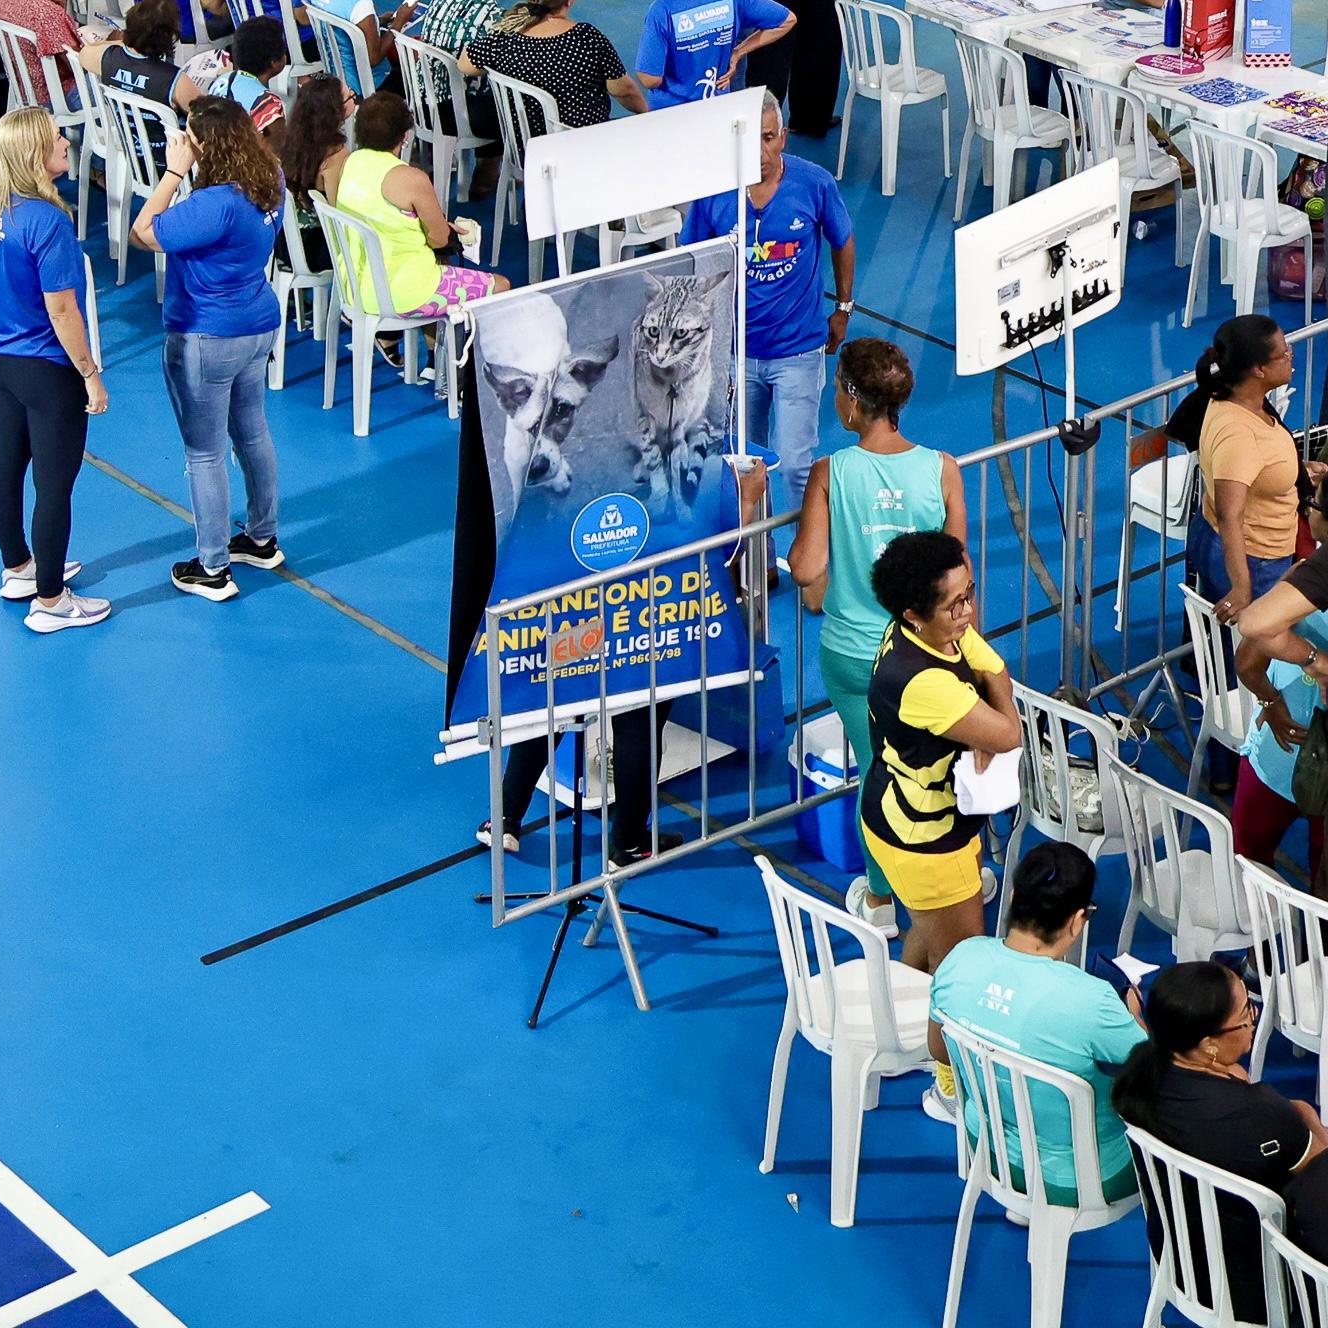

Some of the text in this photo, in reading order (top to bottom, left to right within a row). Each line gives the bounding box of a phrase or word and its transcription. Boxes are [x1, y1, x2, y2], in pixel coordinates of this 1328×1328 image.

[694, 5, 730, 22] SALVADOR
[746, 257, 798, 282] alvador
[583, 526, 638, 544] SALVADOR
[591, 539, 629, 550] PREFEITURA
[681, 564, 711, 593] DE
[612, 604, 630, 634] É
[554, 625, 603, 661] ELO
[616, 630, 680, 655] LIGUE
[686, 622, 722, 642] 190
